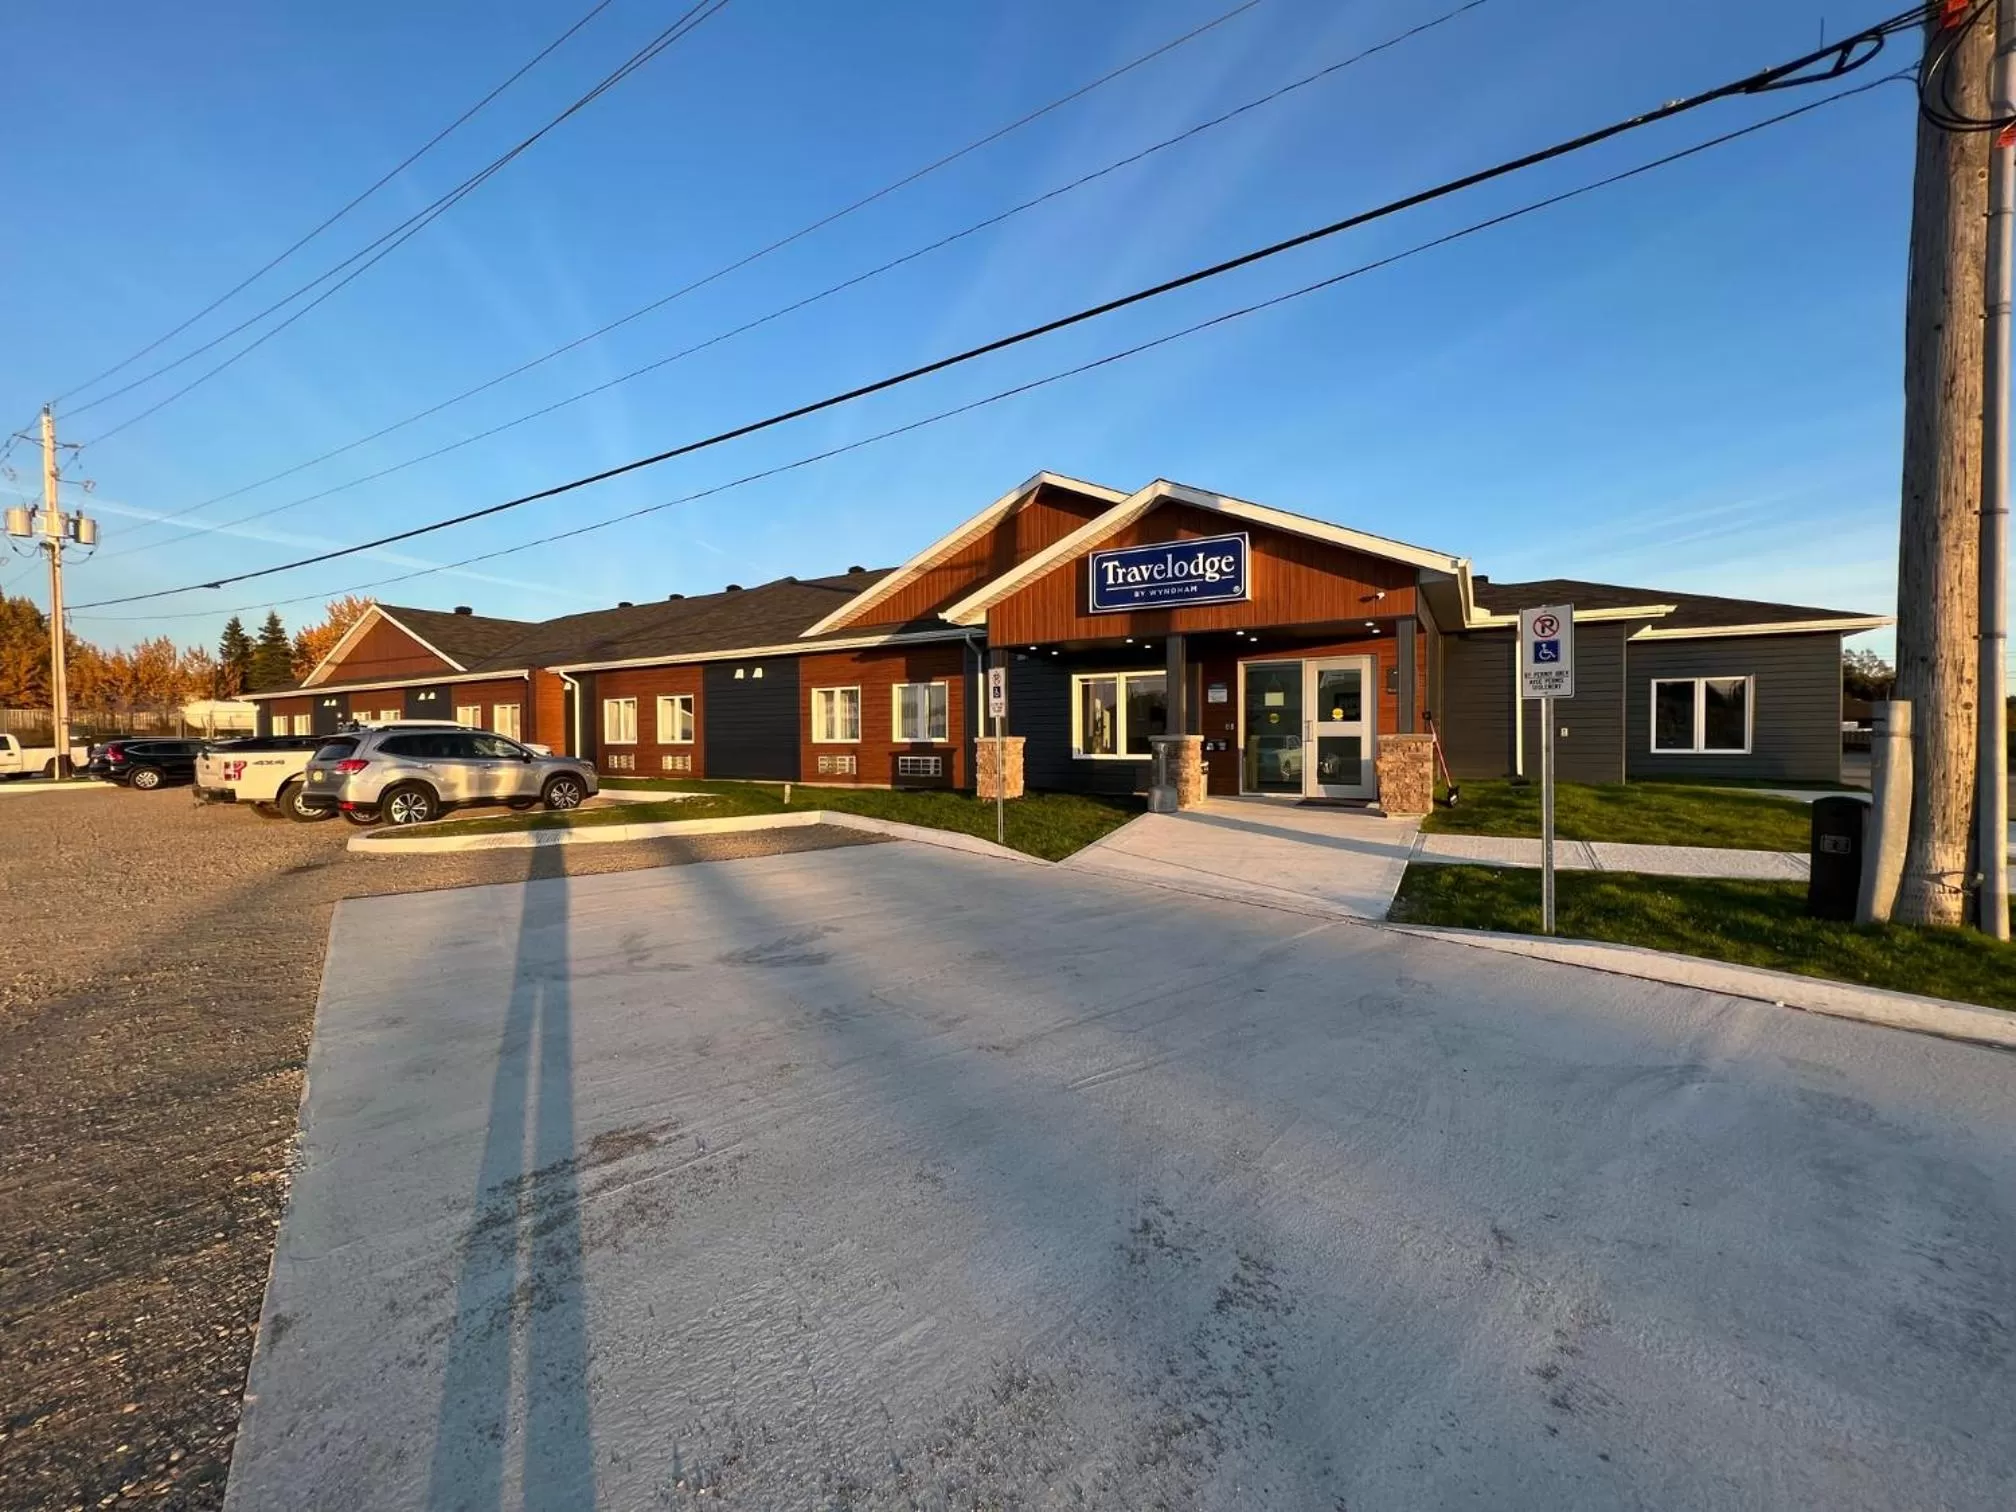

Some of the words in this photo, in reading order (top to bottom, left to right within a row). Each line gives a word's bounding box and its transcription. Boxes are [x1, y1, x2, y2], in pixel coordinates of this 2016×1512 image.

[1102, 552, 1235, 582] Travelodge
[1134, 590, 1145, 598] BY
[1149, 585, 1198, 597] WYNDHAM
